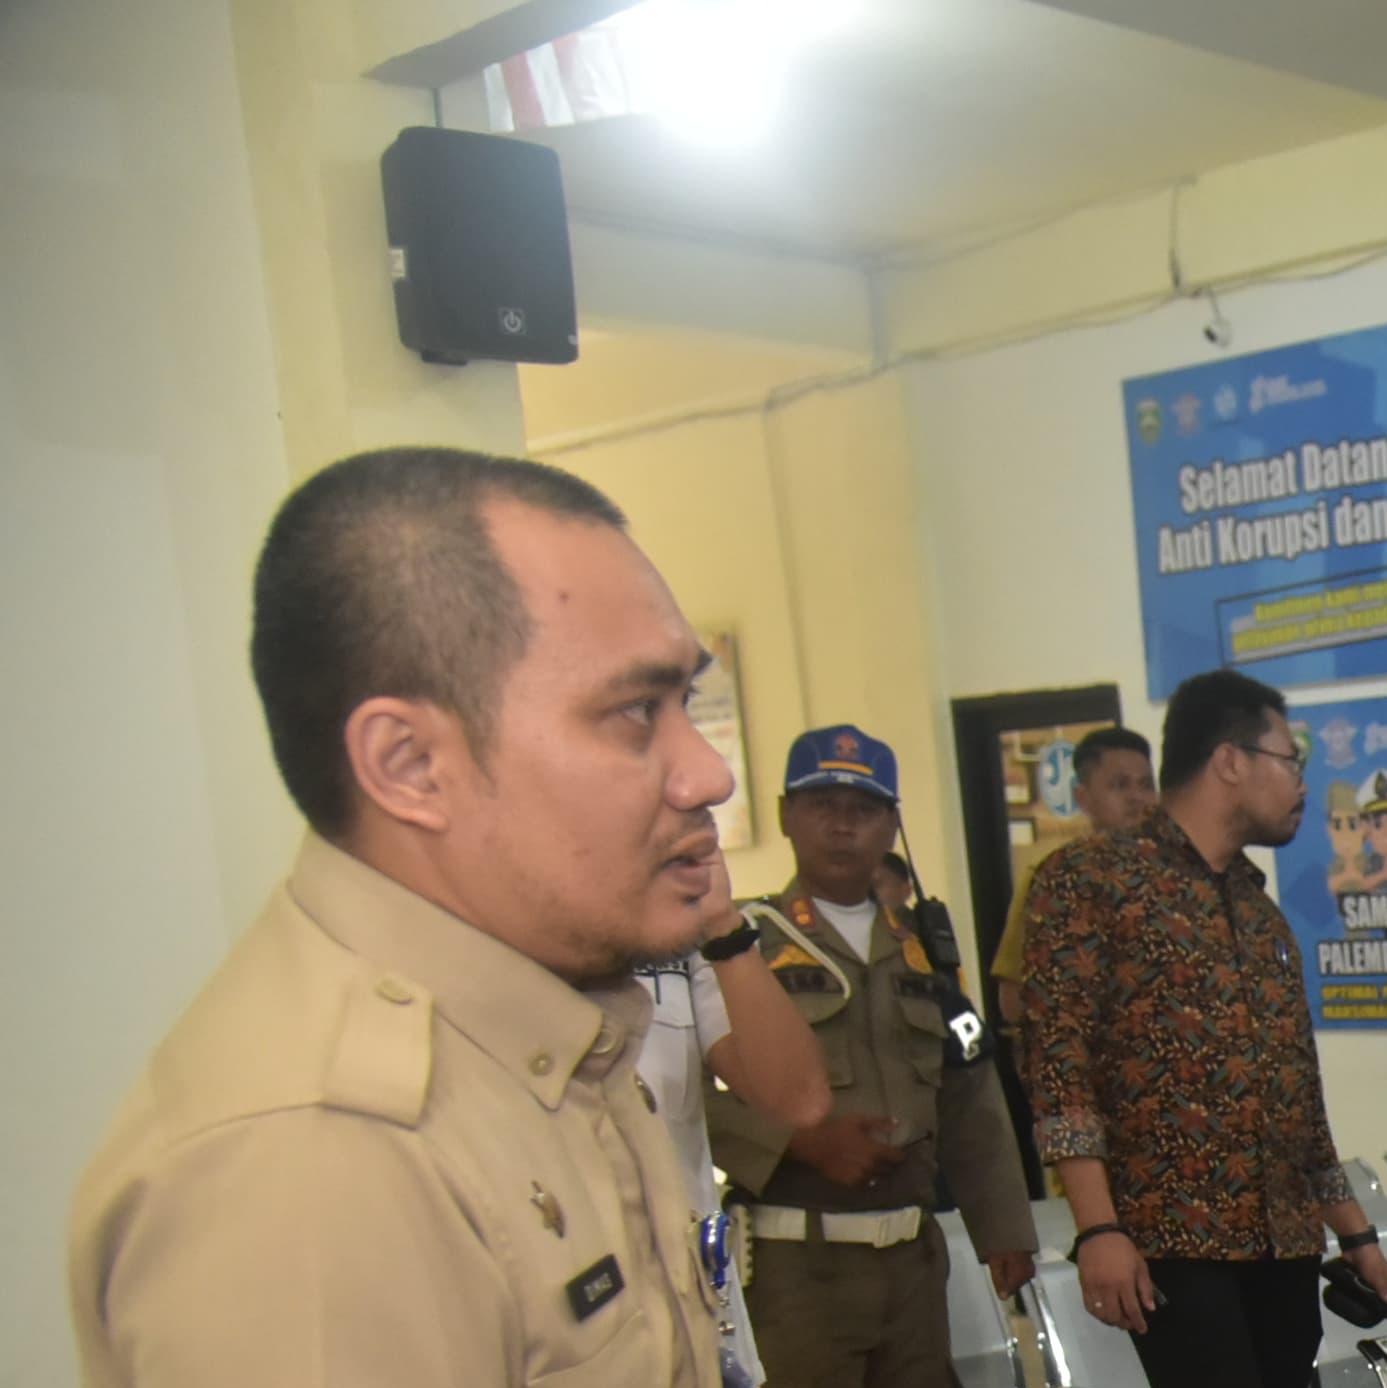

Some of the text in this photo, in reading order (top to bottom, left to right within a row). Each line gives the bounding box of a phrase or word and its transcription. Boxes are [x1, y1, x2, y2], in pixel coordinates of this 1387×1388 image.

[1179, 452, 1298, 514] Selamat
[1158, 518, 1212, 574] Anti
[1216, 500, 1329, 566] Korupsi
